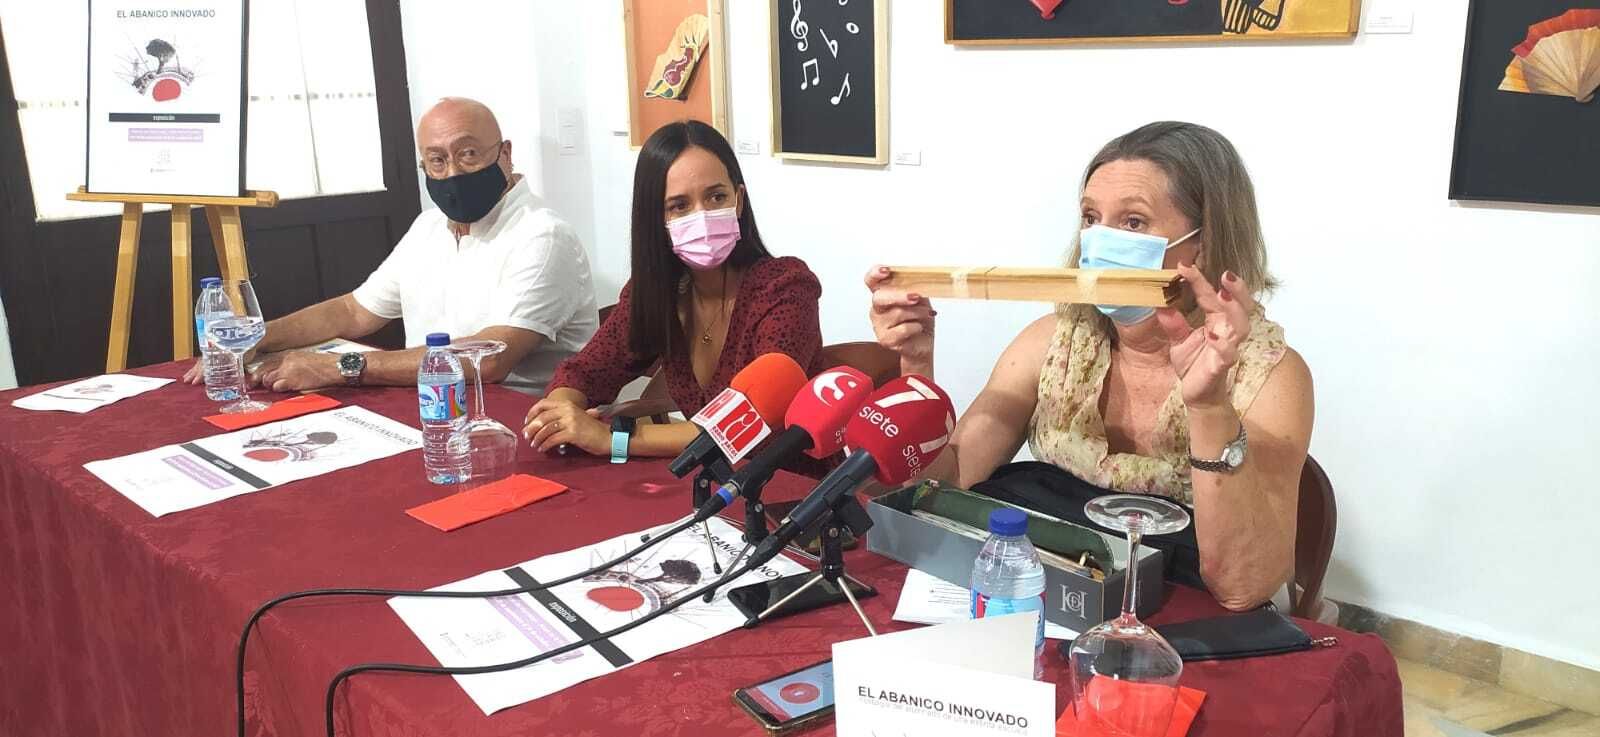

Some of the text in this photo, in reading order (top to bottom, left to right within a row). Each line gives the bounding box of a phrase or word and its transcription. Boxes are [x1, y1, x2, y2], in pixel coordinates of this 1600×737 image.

[116, 9, 216, 18] EL ABANICO INNOVADO
[858, 405, 900, 438] siete
[858, 686, 875, 699] EL
[879, 690, 944, 712] ABANICO
[949, 703, 1028, 728] INNOVADO
